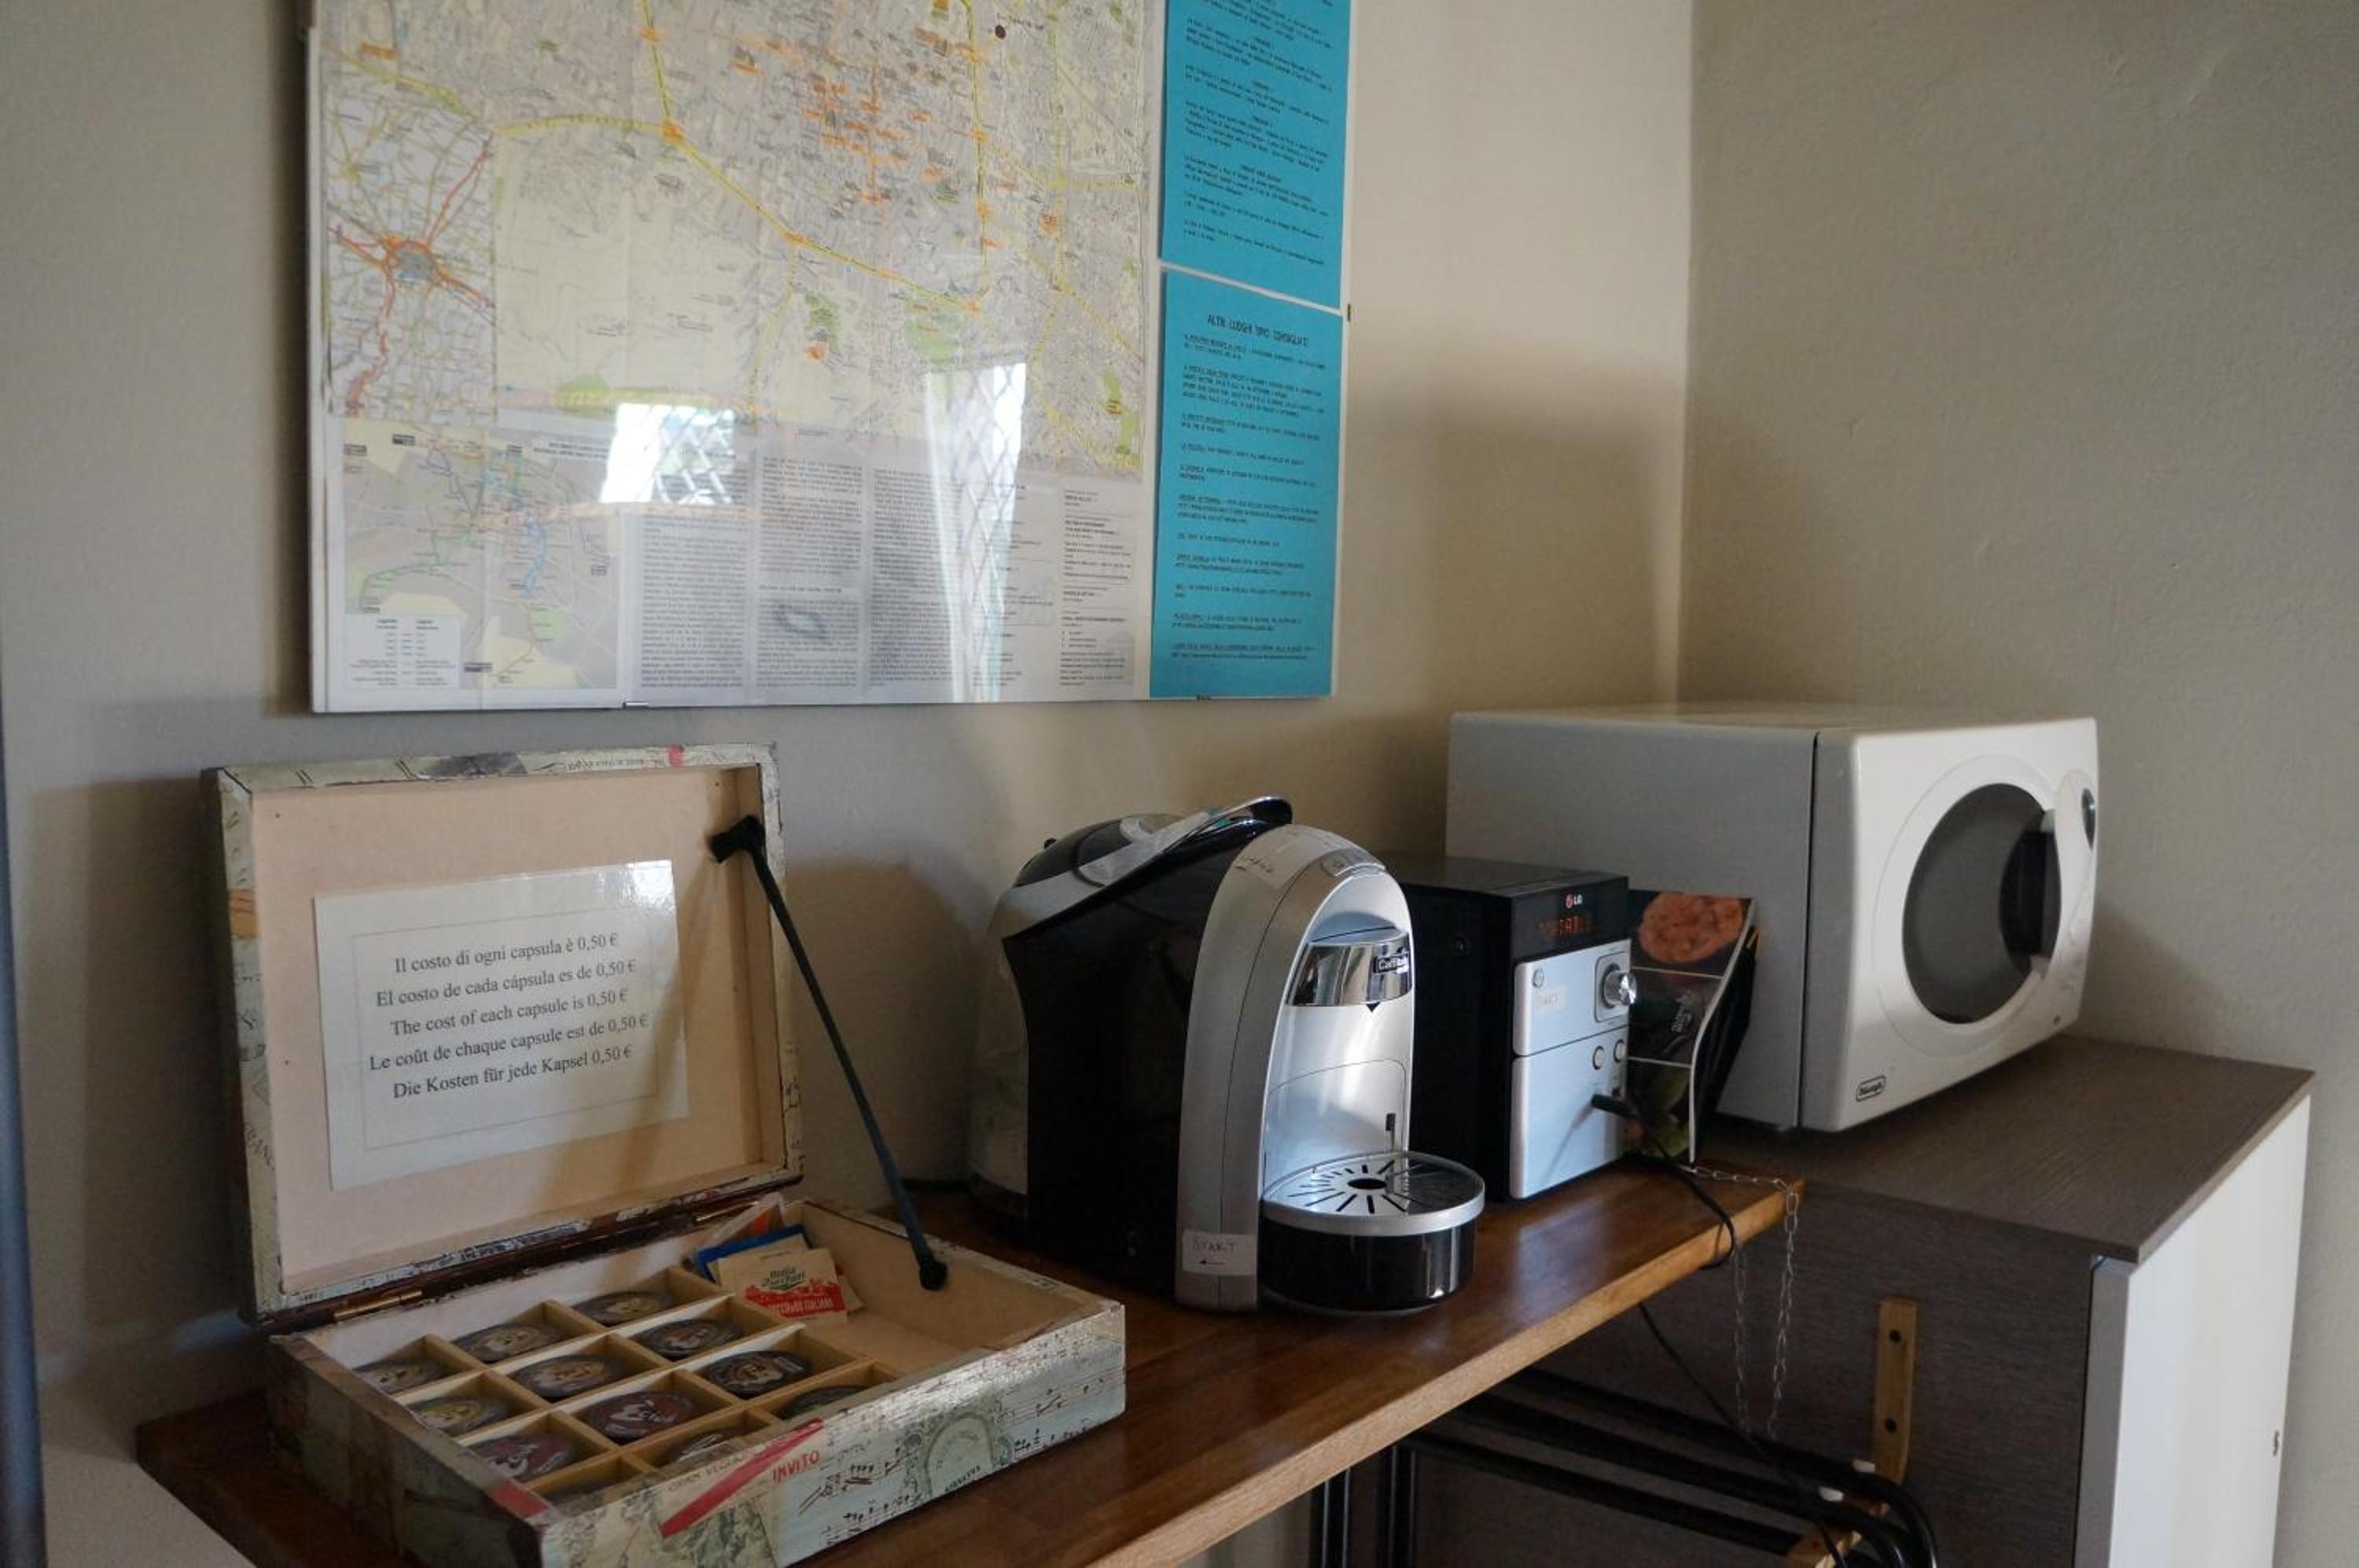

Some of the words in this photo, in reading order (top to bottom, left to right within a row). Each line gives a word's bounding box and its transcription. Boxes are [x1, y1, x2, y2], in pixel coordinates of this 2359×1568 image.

[395, 957, 407, 973] Il
[411, 956, 451, 971] costo
[456, 950, 469, 966] di
[474, 945, 506, 969] ogni
[510, 937, 562, 962] capsula
[565, 939, 574, 952] è
[577, 934, 607, 951] 0,50
[377, 990, 393, 1007] El
[399, 988, 439, 1003] costo
[443, 982, 462, 998] de
[466, 978, 499, 995] cada
[502, 970, 554, 993] cápsula
[559, 971, 573, 982] es
[576, 964, 592, 979] de
[596, 960, 626, 977] 0,50
[391, 1021, 421, 1036] The
[425, 1017, 456, 1031] cost
[460, 1010, 478, 1026] of
[480, 1006, 513, 1024] each
[517, 996, 568, 1020] capsule
[572, 996, 583, 1010] is
[587, 990, 616, 1009] 0,50
[370, 1055, 391, 1071] Le
[396, 1043, 429, 1067] coût
[433, 1044, 451, 1062] de
[455, 1037, 506, 1059] chaque
[510, 1029, 562, 1051] capsule
[566, 1025, 585, 1039] est
[589, 1019, 605, 1036] de
[608, 1015, 636, 1033] 0,50
[393, 1082, 421, 1099] Die
[426, 1073, 479, 1093] Kosten
[484, 1066, 503, 1083] für
[507, 1061, 538, 1083] jede
[541, 1051, 588, 1075] Kapsel
[591, 1047, 621, 1065] 0,50
[772, 1449, 819, 1483] INVITO
